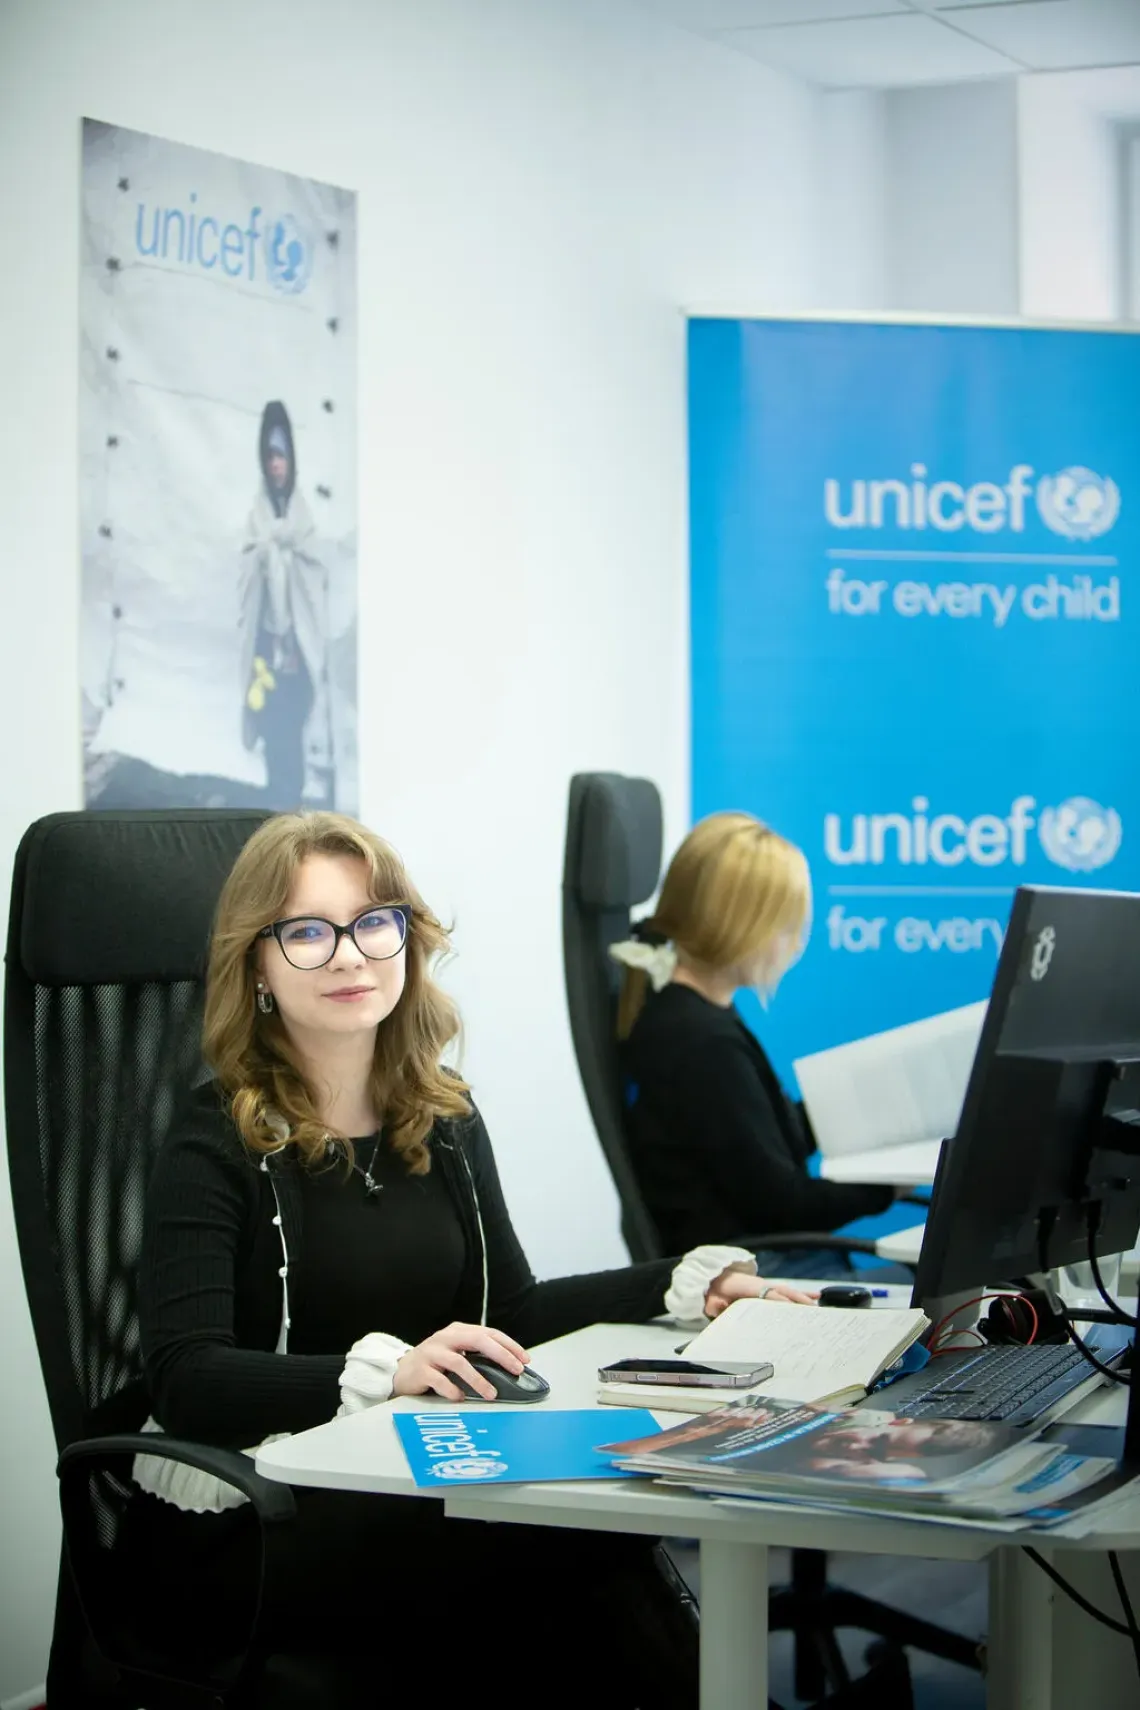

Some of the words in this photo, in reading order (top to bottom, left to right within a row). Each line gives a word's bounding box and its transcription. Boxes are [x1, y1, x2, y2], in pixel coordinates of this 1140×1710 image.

[136, 192, 262, 281] unicef
[825, 463, 1034, 532] unicef
[826, 568, 888, 616] for
[893, 580, 1016, 628] every
[1021, 574, 1121, 622] child
[824, 796, 1036, 866] unicef
[826, 904, 888, 951] for
[414, 1413, 502, 1457] unicef
